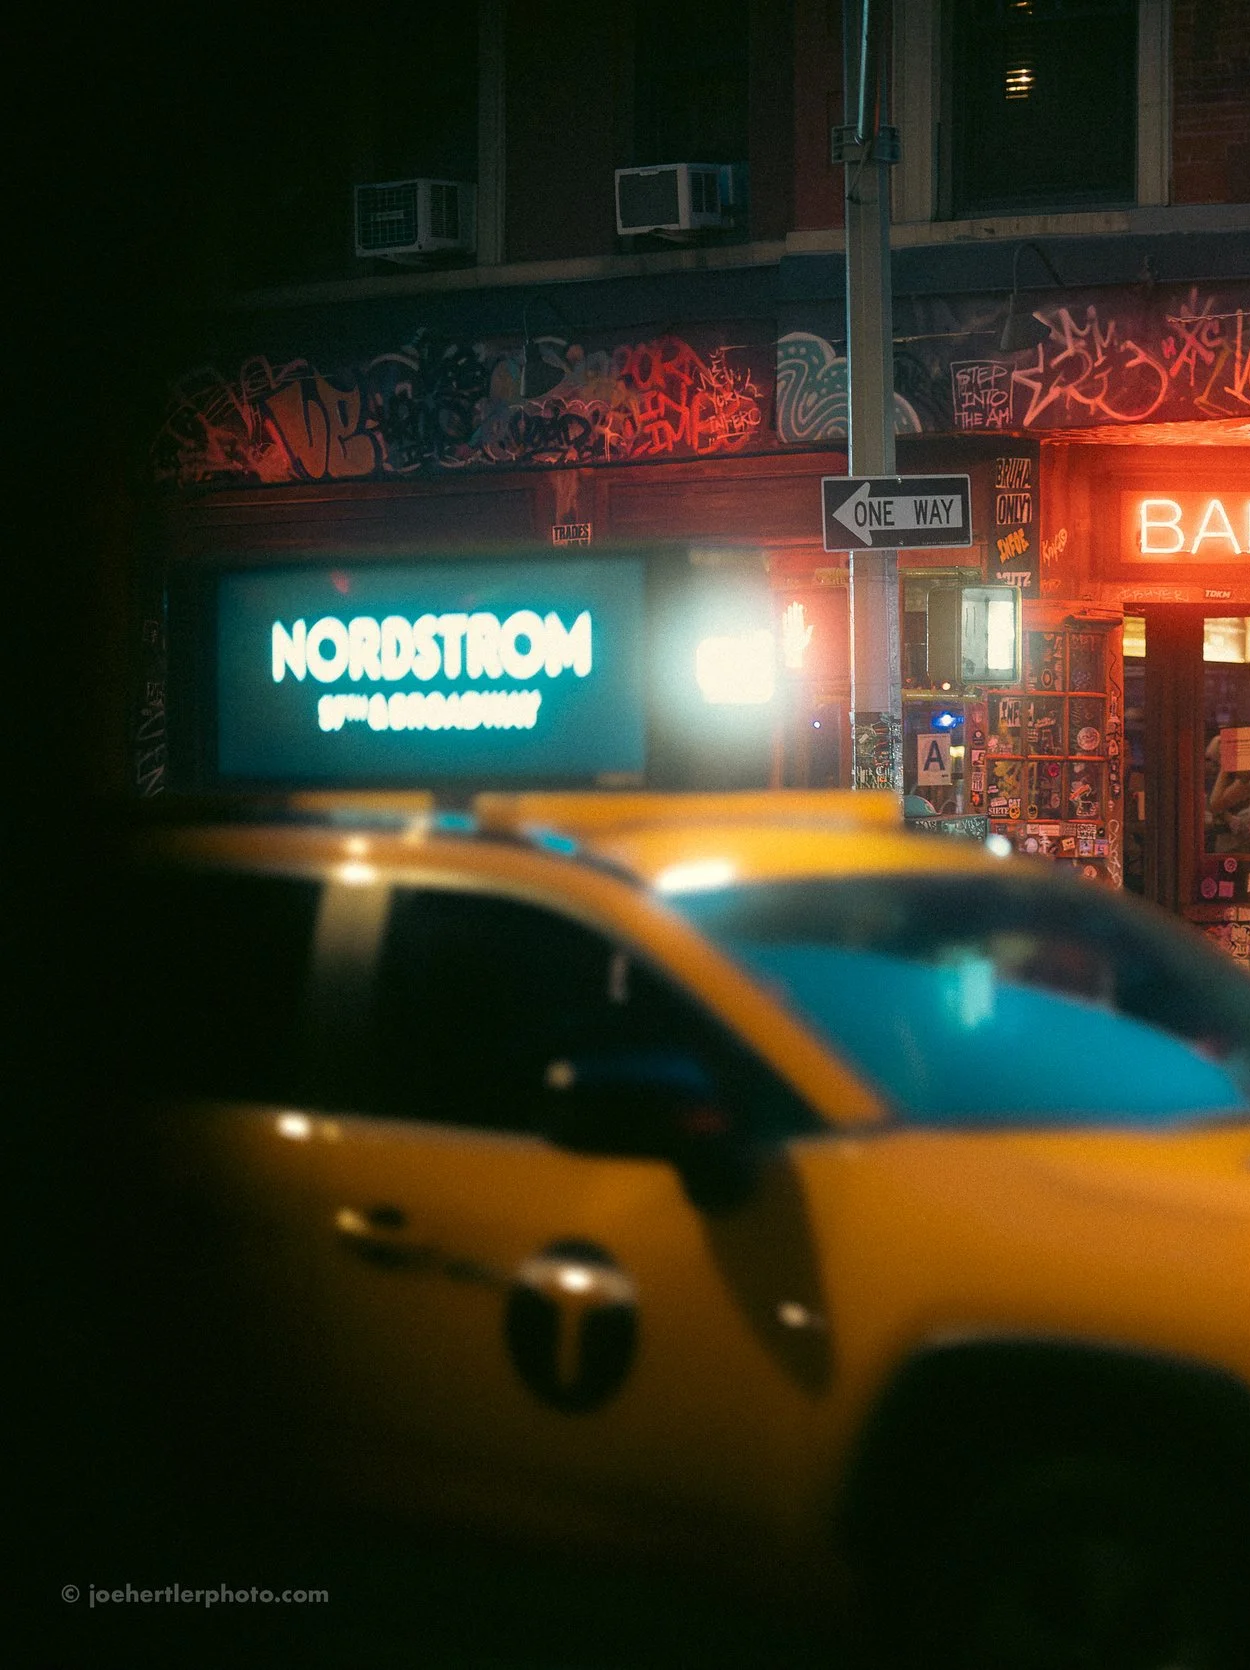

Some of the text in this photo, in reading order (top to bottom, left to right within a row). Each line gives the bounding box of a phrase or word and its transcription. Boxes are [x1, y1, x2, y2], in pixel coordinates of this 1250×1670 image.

[956, 365, 1009, 390] STEP
[961, 389, 1009, 408] INTO
[954, 411, 983, 430] THE
[854, 498, 954, 528] ONE WAY
[553, 525, 589, 541] TRADES
[271, 609, 593, 684] NORDSTROM
[923, 740, 946, 772] A
